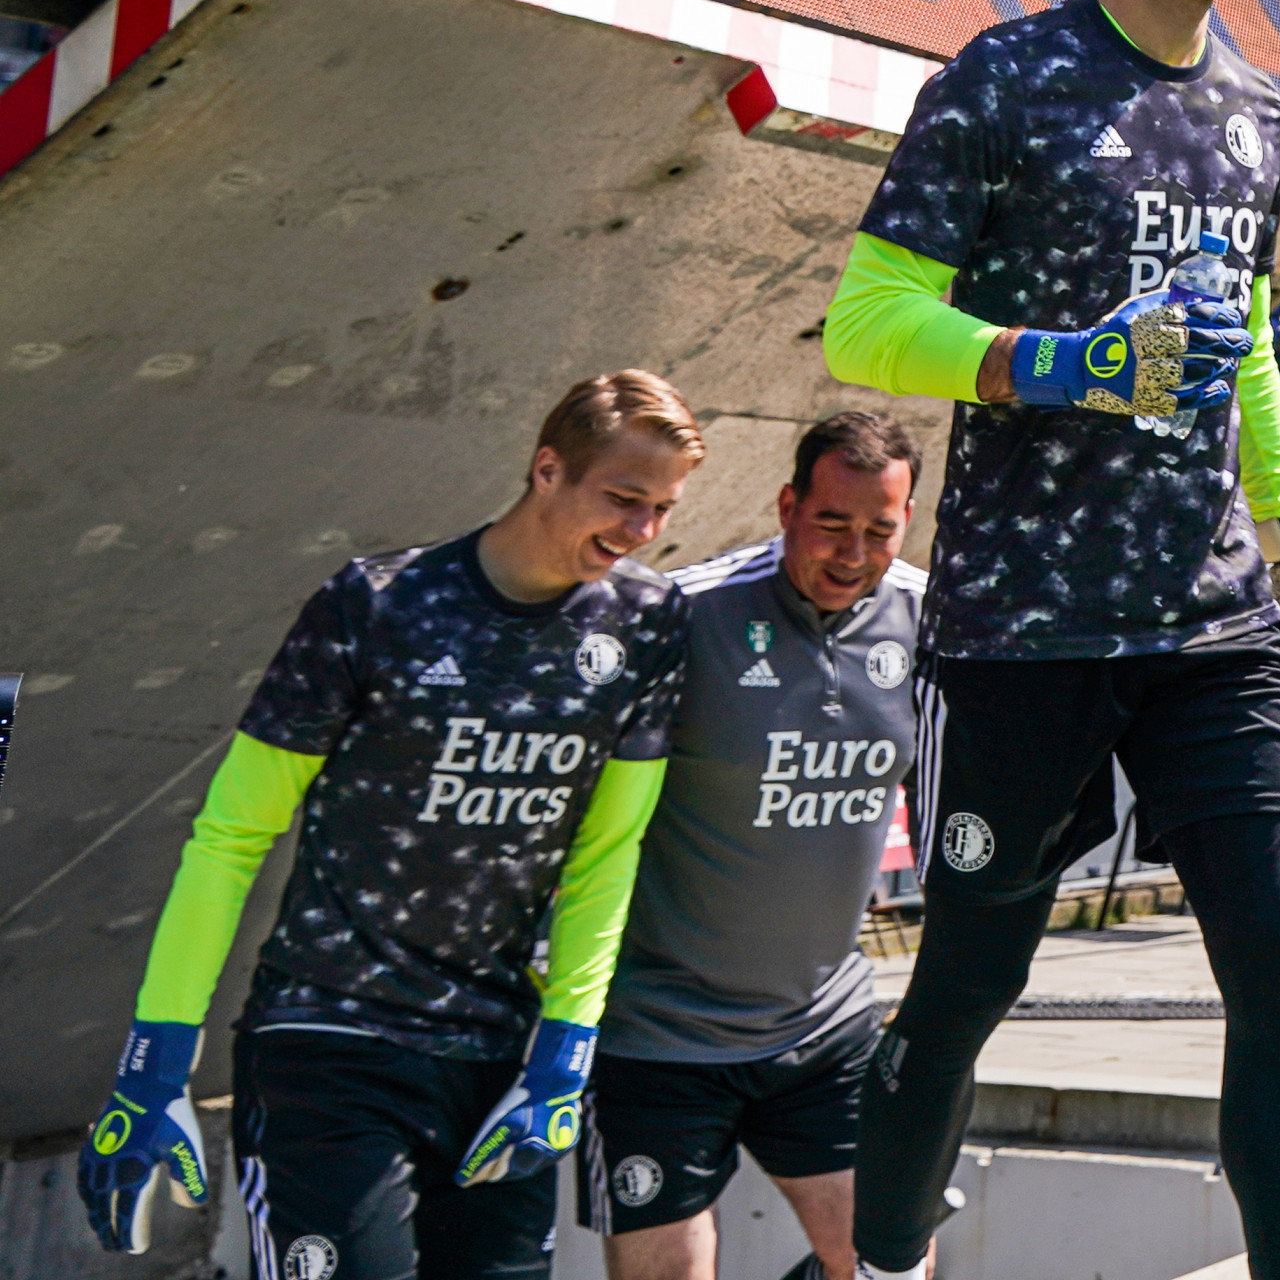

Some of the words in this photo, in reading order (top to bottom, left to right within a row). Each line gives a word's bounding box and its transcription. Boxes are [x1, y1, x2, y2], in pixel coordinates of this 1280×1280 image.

[1090, 145, 1132, 158] adidas
[1131, 190, 1257, 254] Euro
[433, 717, 586, 775] Euro
[761, 730, 896, 781] Euro
[416, 773, 573, 825] Parcs
[753, 783, 887, 827] Parcs
